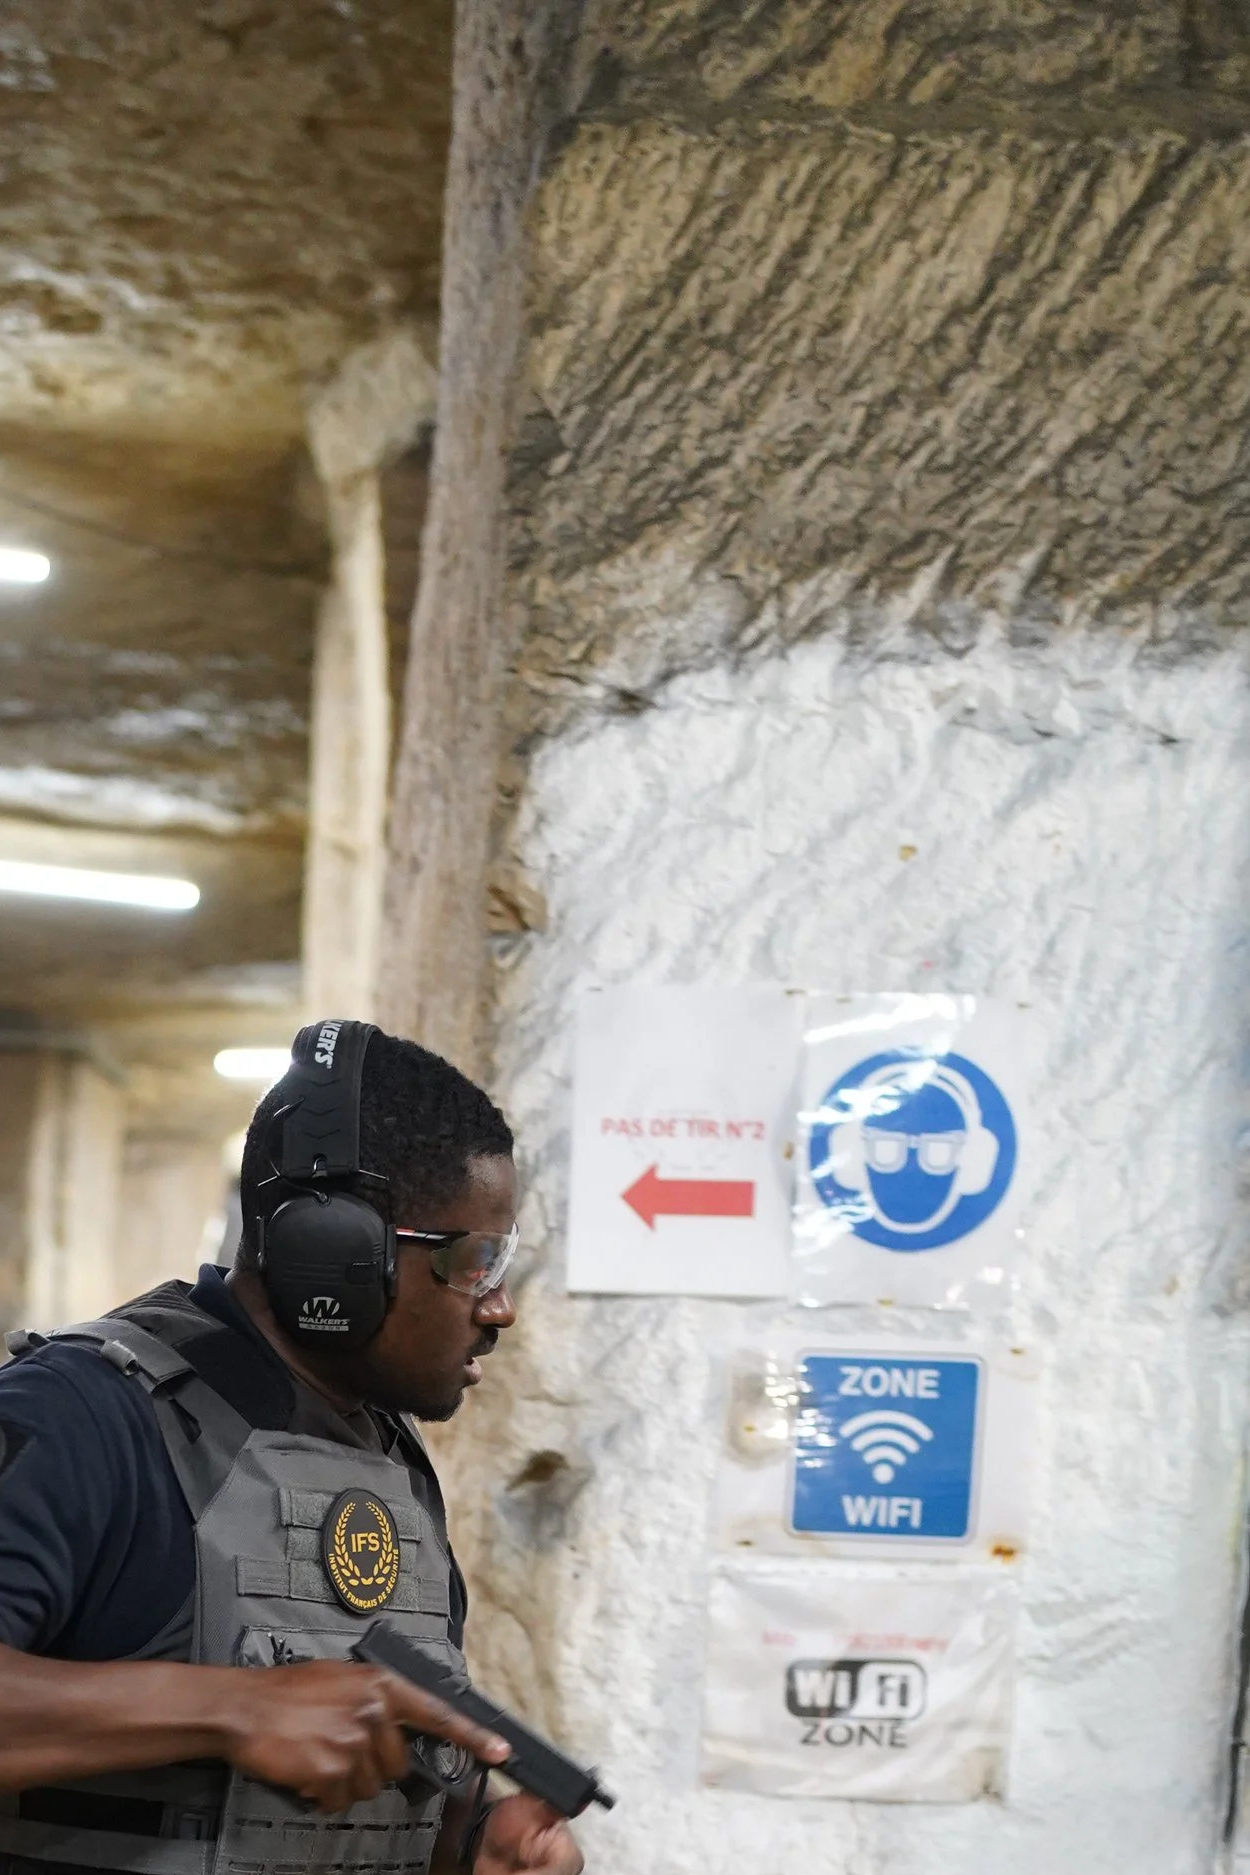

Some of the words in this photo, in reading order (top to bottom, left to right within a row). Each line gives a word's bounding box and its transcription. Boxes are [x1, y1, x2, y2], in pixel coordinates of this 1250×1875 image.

[600, 1117, 644, 1138] PAS
[649, 1117, 677, 1138] DE
[683, 1118, 721, 1140] TIR
[298, 1315, 350, 1326] WALKER'S
[838, 1365, 941, 1399] ZONE
[841, 1494, 923, 1529] WIFI
[350, 1532, 380, 1553] IFS
[328, 1553, 348, 1594] INSTITUT
[346, 1591, 378, 1609] FRANÇAIS
[377, 1590, 388, 1604] DE
[800, 1720, 908, 1748] ZONE
